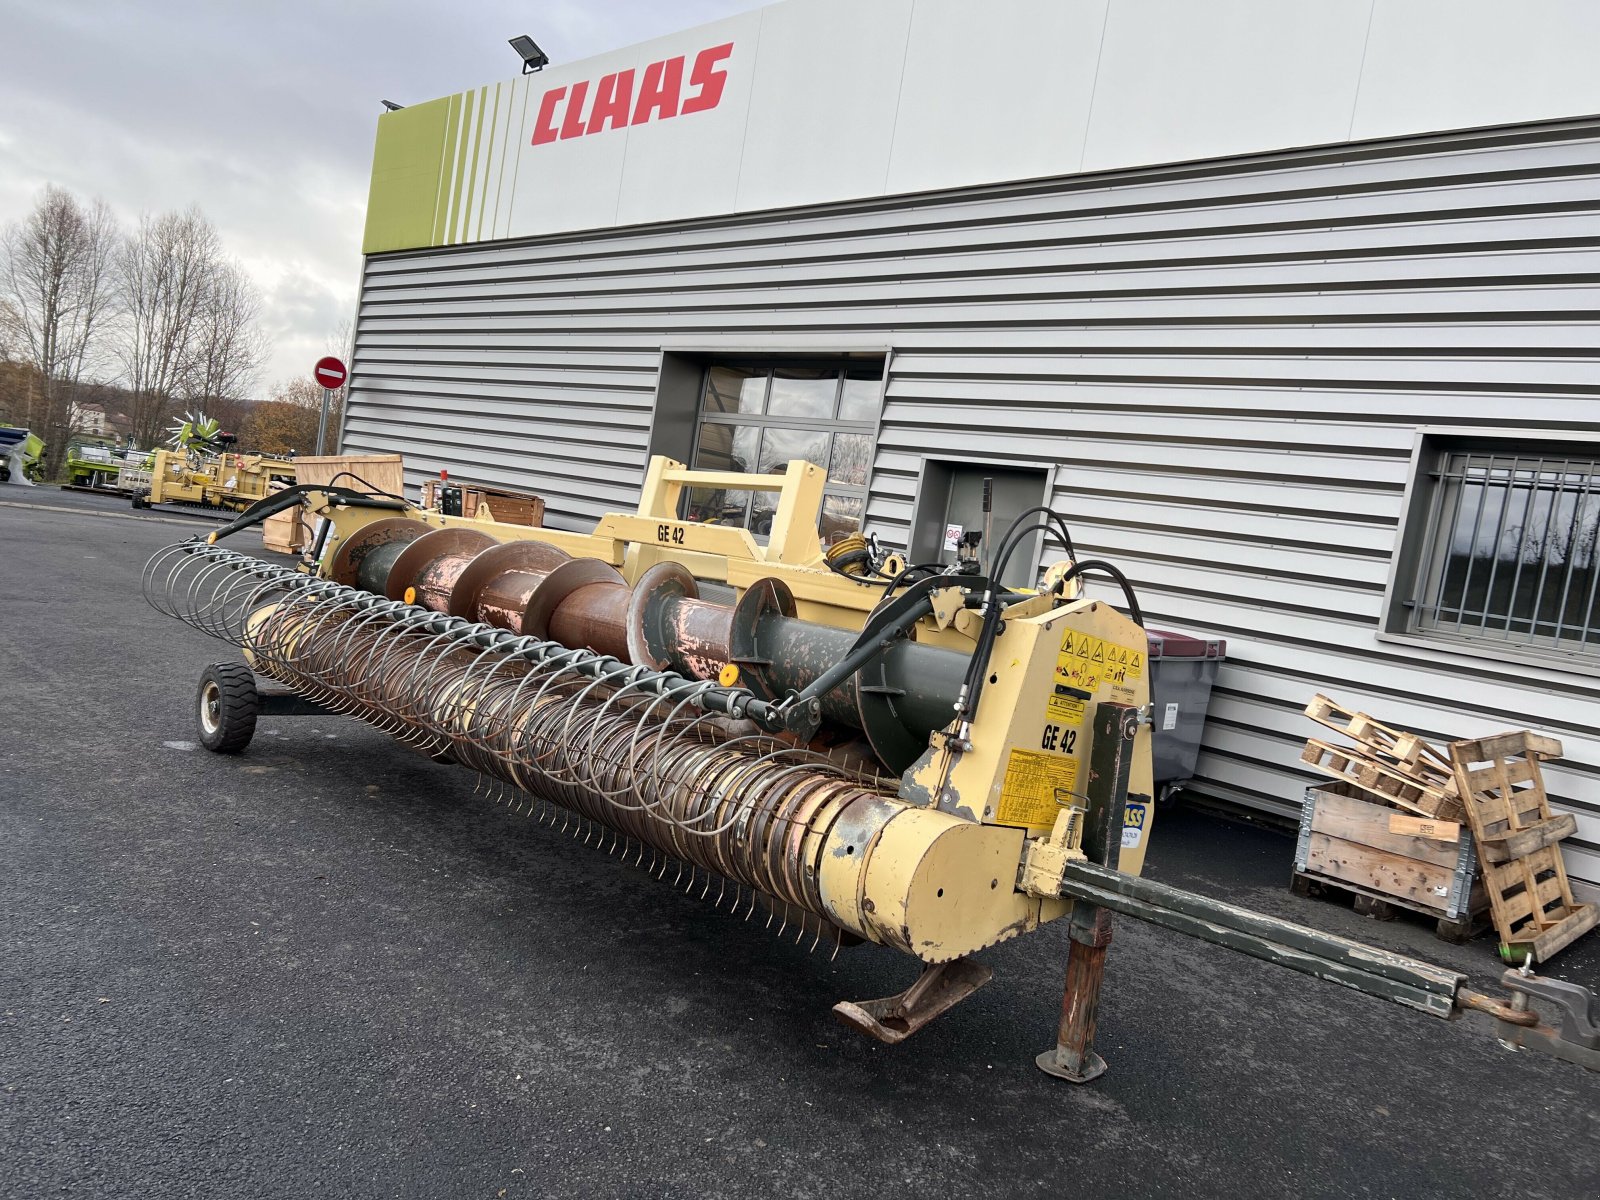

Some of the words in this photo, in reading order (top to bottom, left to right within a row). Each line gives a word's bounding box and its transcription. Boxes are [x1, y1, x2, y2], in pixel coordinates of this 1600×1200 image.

[531, 42, 735, 146] CLAAS
[658, 524, 669, 543] GE
[672, 527, 684, 544] 42
[1041, 724, 1060, 751] GE
[1060, 729, 1077, 755] 42
